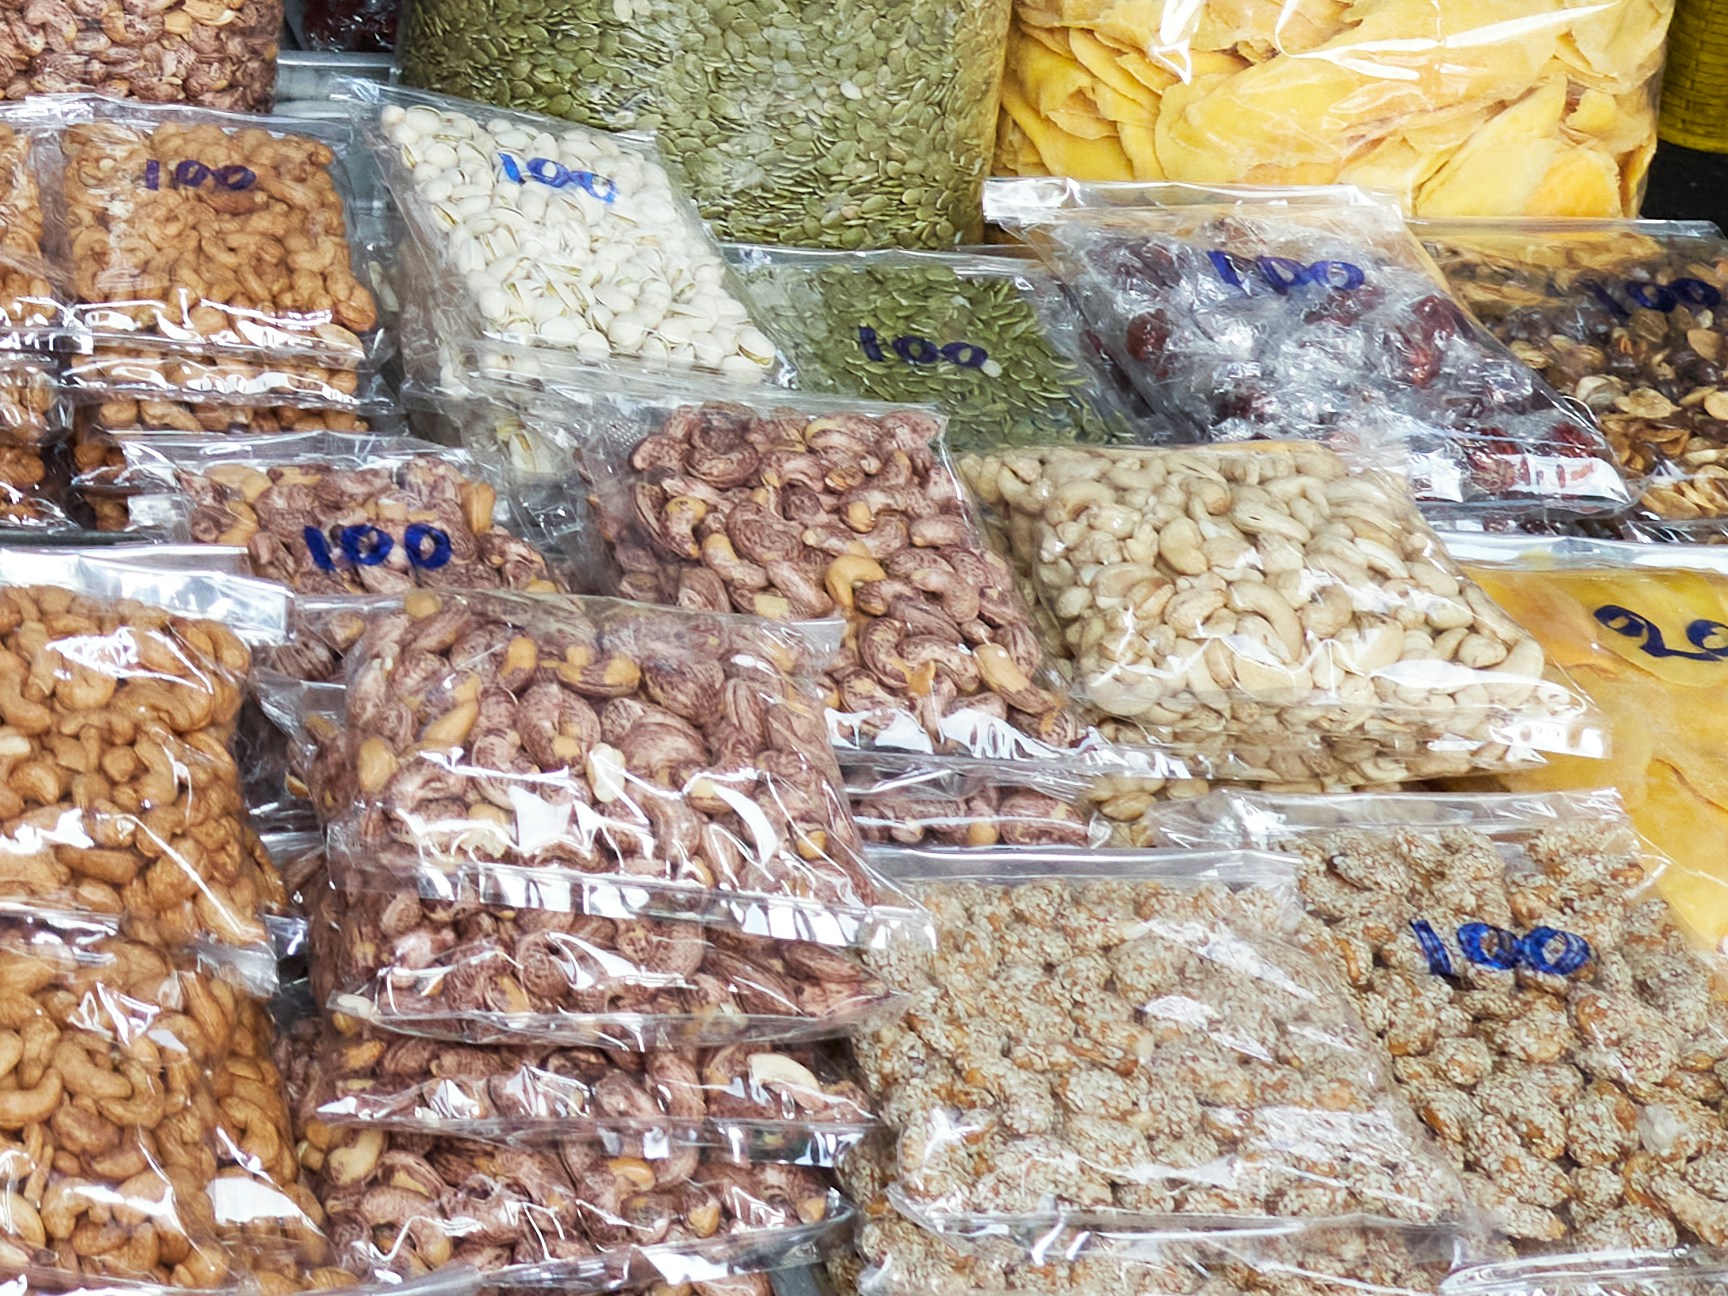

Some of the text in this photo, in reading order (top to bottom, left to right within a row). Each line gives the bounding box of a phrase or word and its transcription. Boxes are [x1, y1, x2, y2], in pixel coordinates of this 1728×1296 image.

[145, 159, 257, 192] 100
[497, 151, 620, 204] 100
[1207, 248, 1367, 292] 100
[858, 324, 990, 371] 100
[303, 522, 453, 573] 100
[1410, 917, 1594, 978] 100
